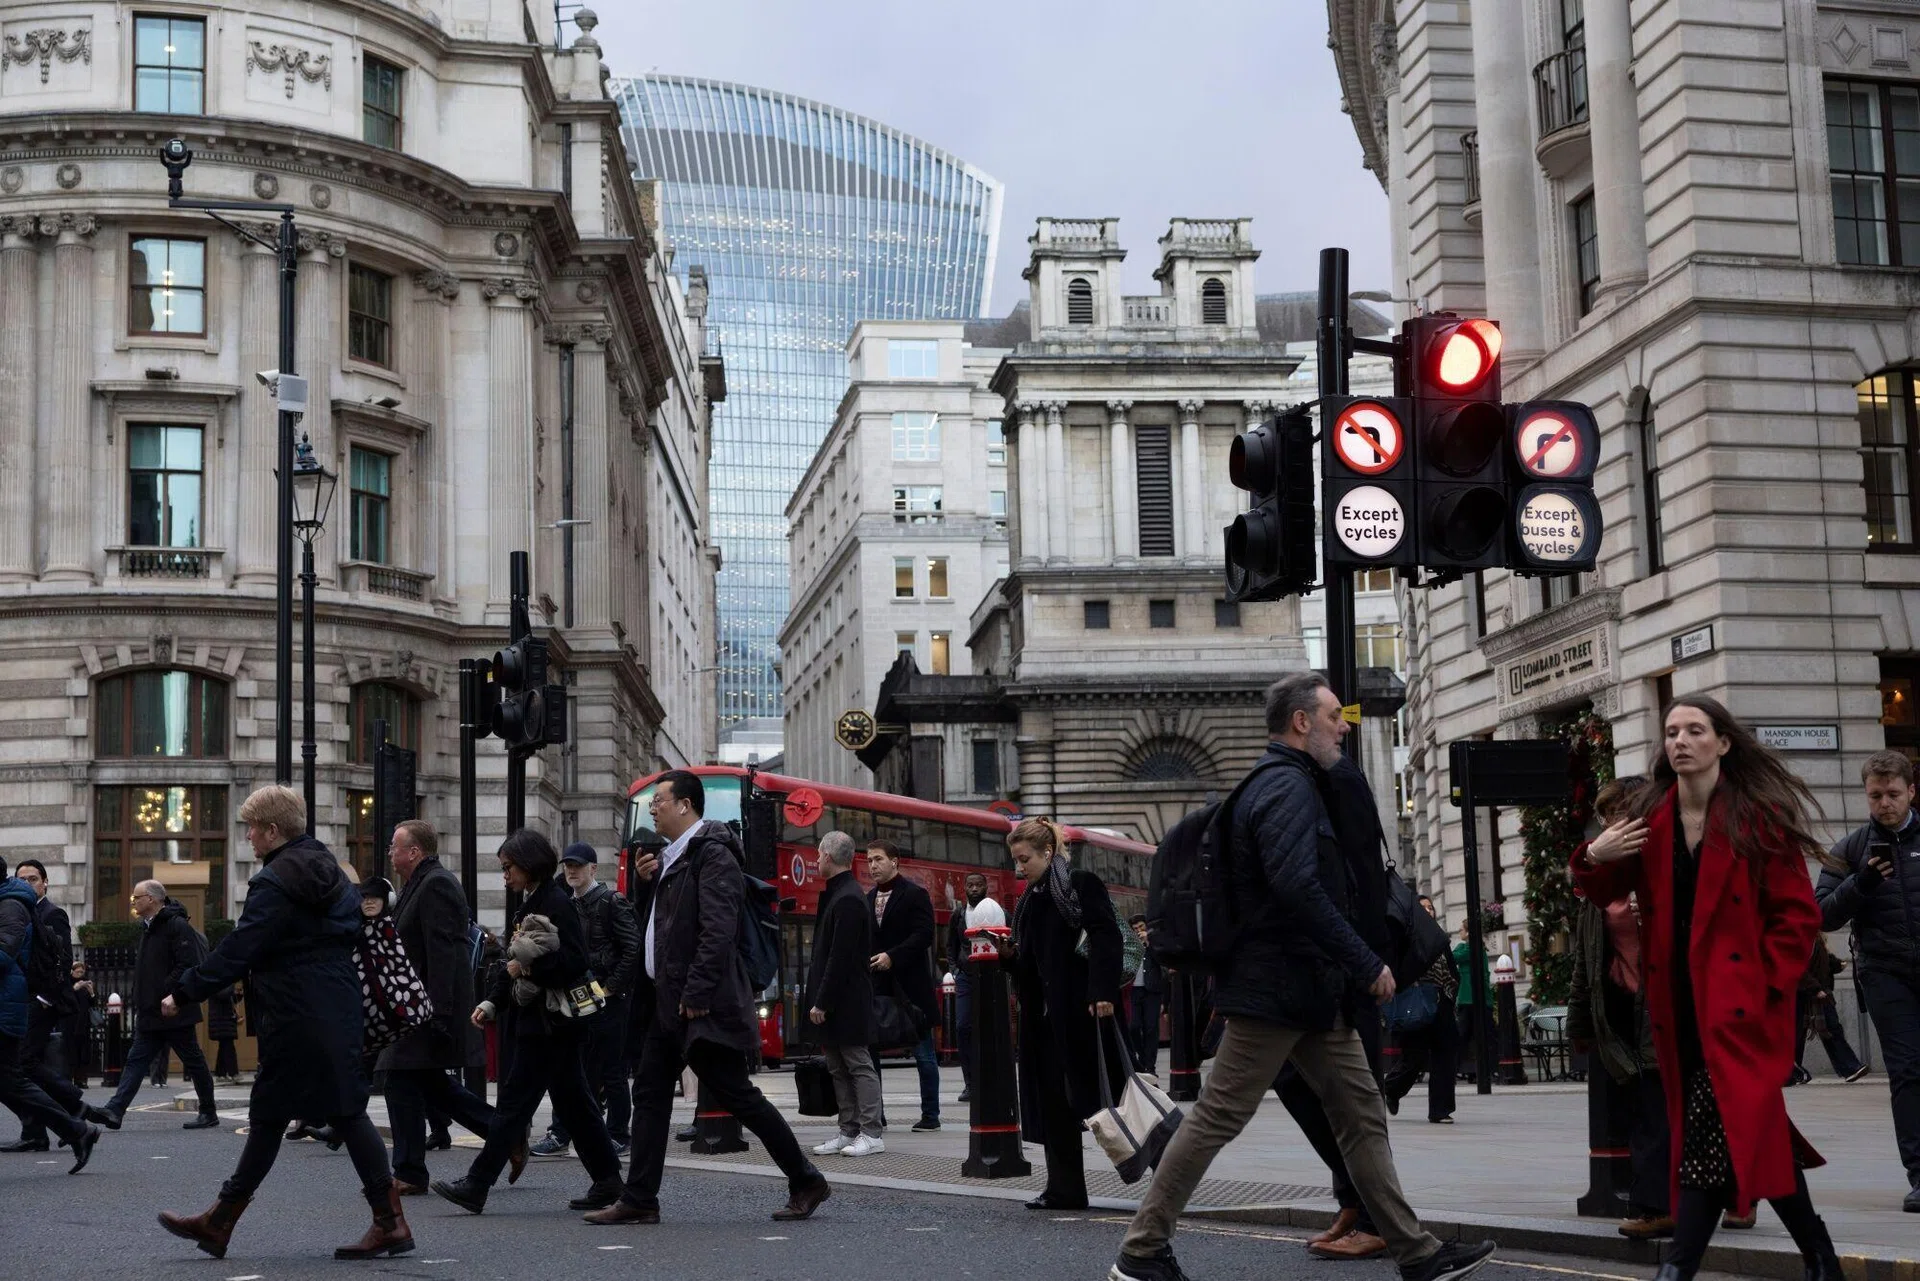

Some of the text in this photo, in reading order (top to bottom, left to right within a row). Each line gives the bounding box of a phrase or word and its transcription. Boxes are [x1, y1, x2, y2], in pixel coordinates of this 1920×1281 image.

[1342, 506, 1399, 523] Except
[1524, 506, 1577, 523] Except
[1345, 525, 1397, 541] cycles
[1521, 523, 1581, 538] buses &
[1528, 541, 1575, 555] cycles
[1522, 653, 1560, 678] LOMBARD
[1562, 640, 1593, 664] STREET
[1764, 729, 1830, 738] MANSION HOUSE
[1765, 738, 1789, 747] PLACE
